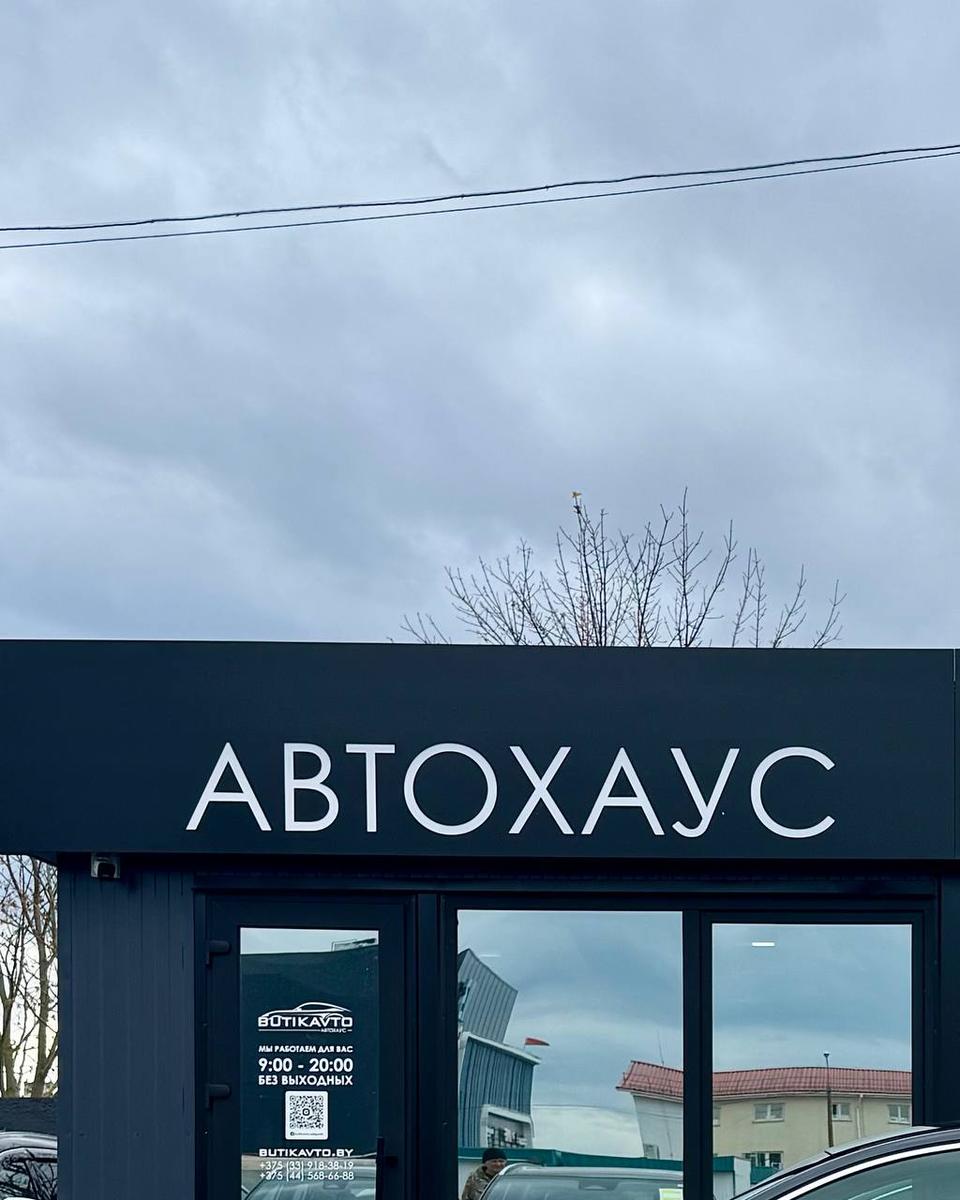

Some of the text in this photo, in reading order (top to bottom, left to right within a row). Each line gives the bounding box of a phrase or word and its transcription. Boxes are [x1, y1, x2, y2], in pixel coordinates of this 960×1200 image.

[185, 741, 836, 838] АВТОХАУС
[257, 1016, 353, 1027] BUTIKAVTO
[258, 1045, 353, 1053] МЫ РАБОТАЕМ ДЛЯ ВАС
[258, 1058, 293, 1072] 9:00
[309, 1058, 354, 1072] 20:00
[258, 1075, 353, 1086] БЕЗ ВЫХОДНЫХ
[259, 1149, 354, 1157] BUTIKAVTO.BY
[259, 1160, 283, 1170] +375
[307, 1171, 354, 1180] 568-66-88
